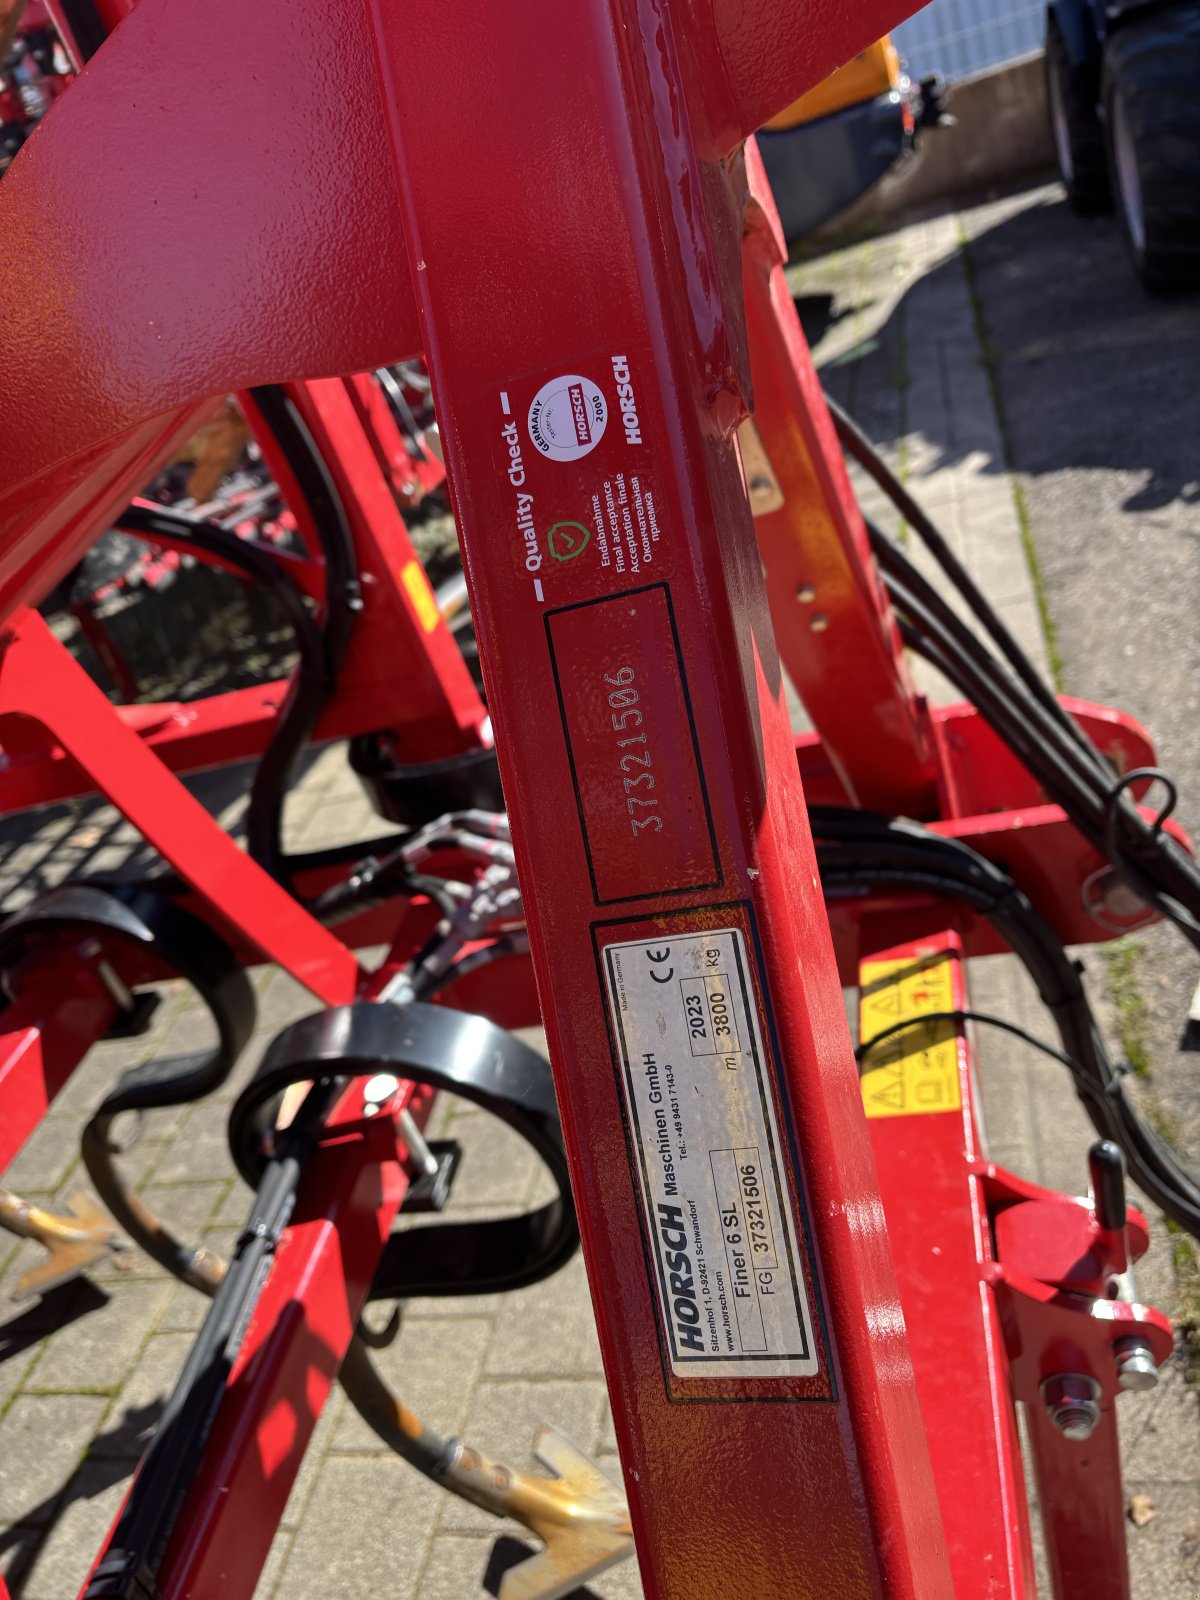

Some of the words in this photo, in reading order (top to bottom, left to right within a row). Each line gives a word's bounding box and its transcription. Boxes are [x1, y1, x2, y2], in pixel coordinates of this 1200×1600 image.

[571, 388, 588, 440] HORSCH
[592, 396, 603, 422] 2000
[611, 355, 642, 444] HORSCH
[531, 400, 550, 451] GERMANY
[502, 421, 525, 487] Check
[603, 481, 620, 543] acceptance
[615, 473, 628, 505] finale
[517, 493, 542, 571] Quality
[591, 494, 610, 567] Endabnahme
[622, 507, 640, 573] Acceptation
[631, 476, 652, 562] Окончательная
[645, 492, 661, 542] приемка
[613, 548, 625, 573] Final
[604, 667, 663, 836] 37321506
[614, 952, 623, 983] Germany
[706, 949, 720, 967] kg
[620, 991, 629, 1011] Made
[686, 995, 707, 1039] 2023
[709, 992, 730, 1036] 3800
[642, 1053, 662, 1104] GmbH
[665, 1064, 676, 1094] 7143-0
[725, 1057, 737, 1070] m
[670, 1098, 681, 1119] 9431
[675, 1122, 683, 1138] +49
[654, 1108, 678, 1196] Maschinen
[680, 1140, 688, 1160] Tel.:
[687, 1199, 704, 1256] Schwandorf
[722, 1202, 739, 1228] SL
[740, 1165, 768, 1253] 37321506
[727, 1233, 742, 1244] 6
[657, 1203, 705, 1352] HORSCH
[700, 1254, 711, 1295] D-92421
[732, 1250, 750, 1298] Finer
[759, 1272, 775, 1294] FG
[704, 1297, 712, 1305] 1,
[716, 1271, 734, 1352] www.horsch.com
[707, 1305, 719, 1352] Sitzenhof
